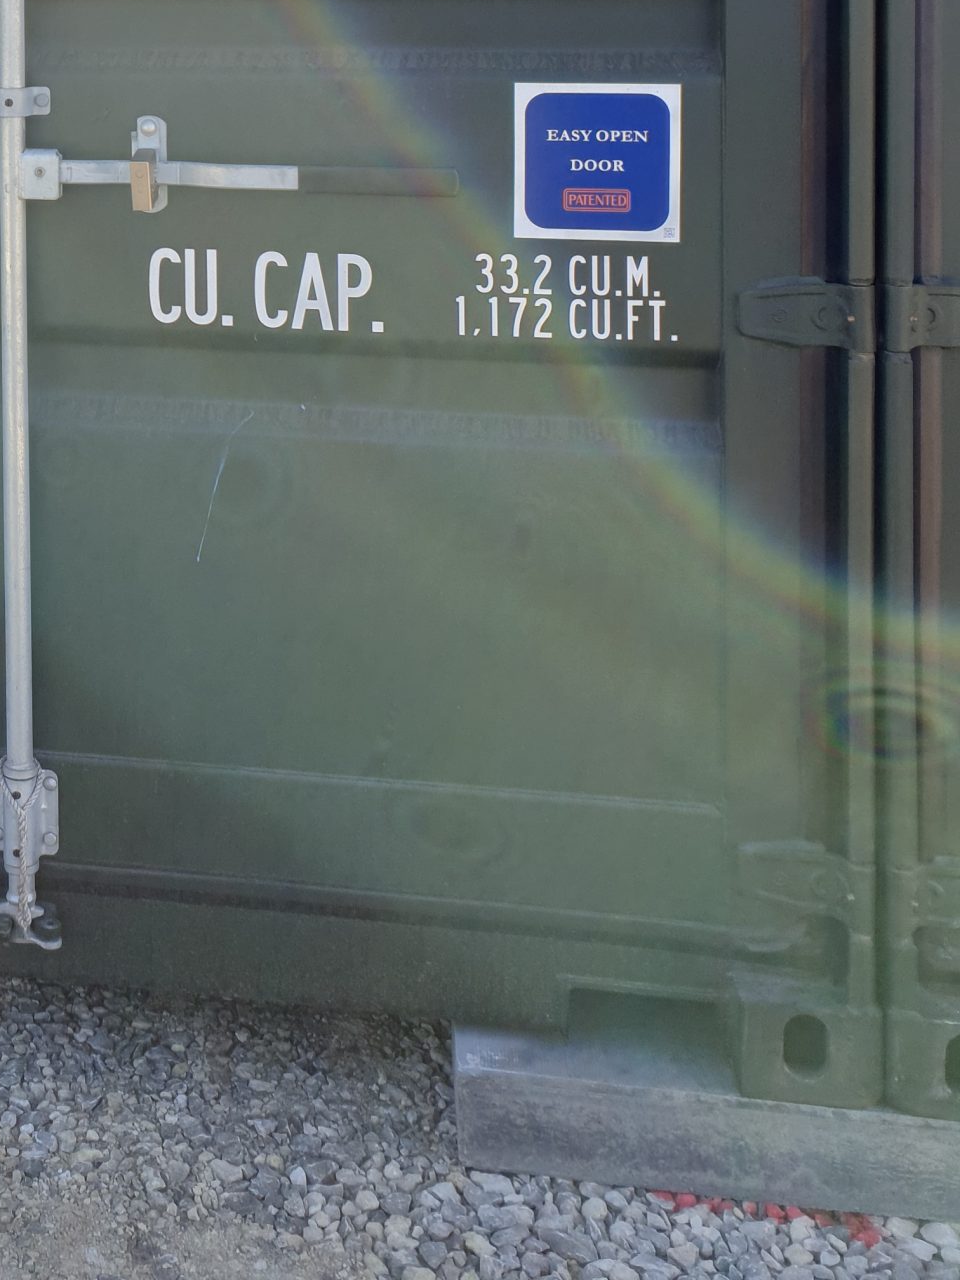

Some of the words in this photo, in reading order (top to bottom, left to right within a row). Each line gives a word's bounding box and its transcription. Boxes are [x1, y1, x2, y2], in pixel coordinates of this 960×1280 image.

[546, 129, 593, 142] EASY
[595, 129, 649, 143] OPEN
[570, 159, 625, 172] DOOR
[568, 194, 628, 207] PATENTED
[148, 247, 234, 327] CU.
[254, 250, 385, 333] CAP.
[475, 252, 553, 296] 33.2
[455, 295, 553, 339] 1,172
